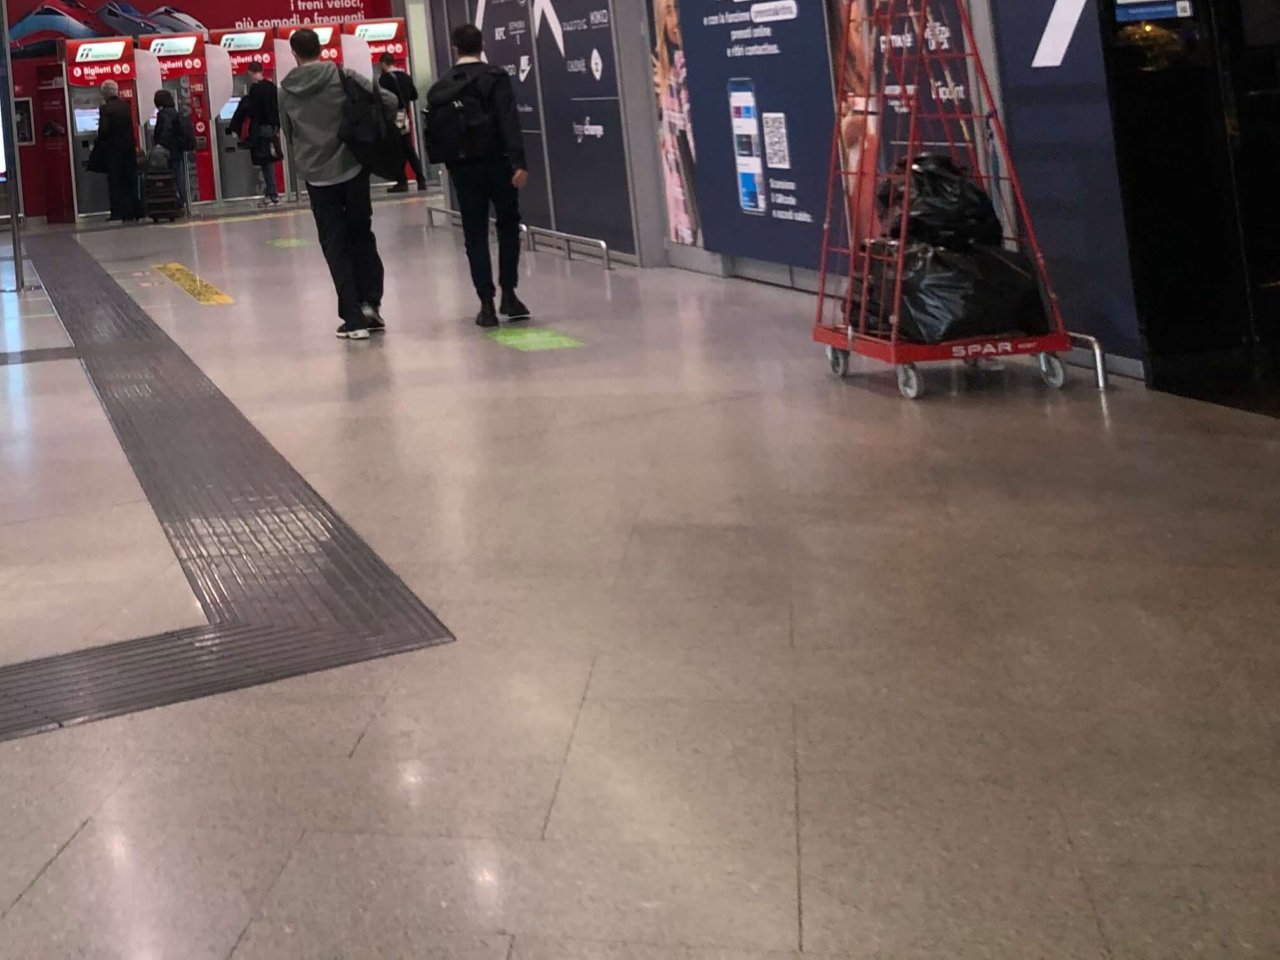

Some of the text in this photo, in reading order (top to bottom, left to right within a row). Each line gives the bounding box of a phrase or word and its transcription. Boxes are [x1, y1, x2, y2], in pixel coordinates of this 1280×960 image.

[235, 10, 365, 29] più comodi e frequenti
[160, 61, 183, 72] iglietti
[229, 56, 253, 66] iglietti
[83, 65, 111, 76] Biglietti
[952, 342, 1013, 357] SPAR
